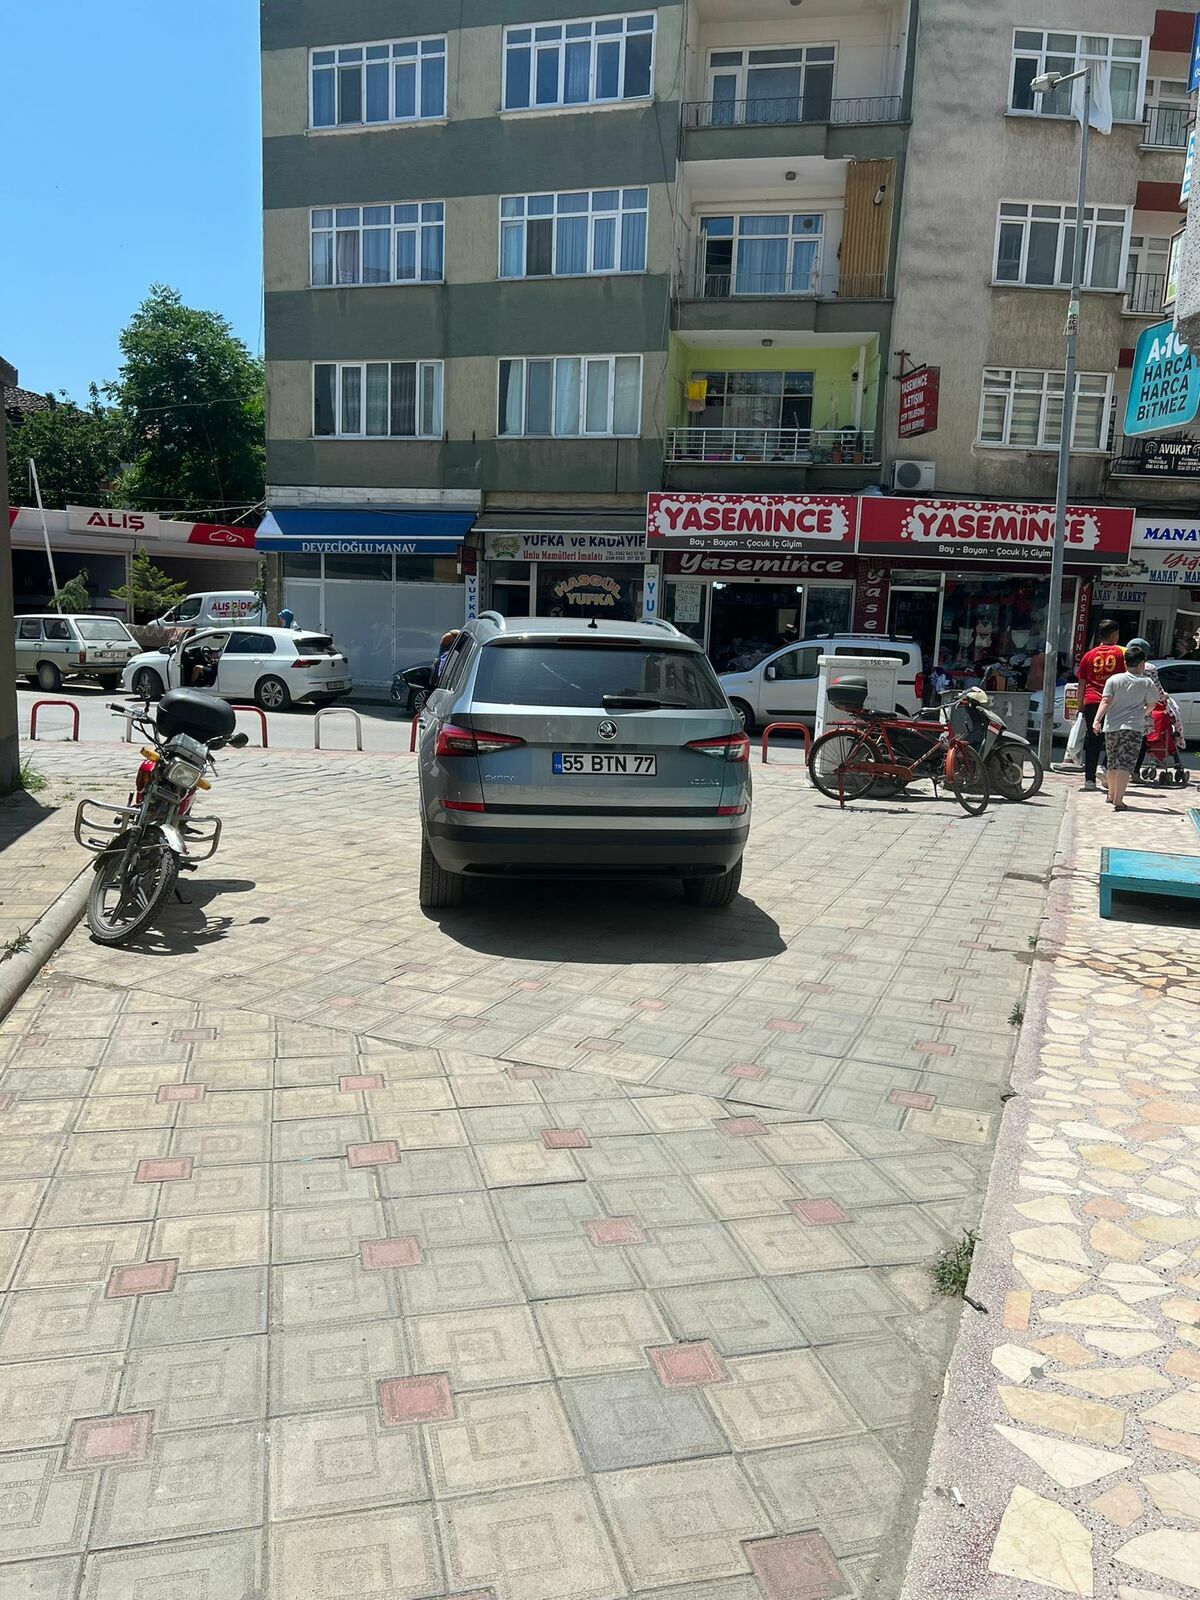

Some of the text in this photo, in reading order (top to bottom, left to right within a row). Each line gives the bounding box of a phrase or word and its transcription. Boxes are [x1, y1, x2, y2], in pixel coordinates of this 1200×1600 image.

[1143, 354, 1192, 383] HARCA
[1140, 375, 1189, 403] HARCA
[1158, 443, 1193, 455] AVUKAT
[664, 499, 833, 533] YASEMİNCE
[523, 535, 565, 547] YUFKA
[570, 536, 586, 547] ve
[589, 535, 645, 547] KADAYIF
[1143, 527, 1200, 542] MANA
[301, 540, 417, 553] DEVECİOĞLU MANAV
[689, 538, 705, 547] Bay
[713, 538, 738, 548] Bayan
[746, 539, 770, 549] Çocuk
[772, 538, 780, 549] İç
[781, 539, 803, 549] Giyim
[938, 544, 954, 554] Bay
[962, 546, 988, 555] Bayan
[996, 547, 1020, 557] Çocuk
[1021, 547, 1029, 558] İç
[1030, 549, 1051, 558] Giyim
[680, 553, 844, 574] Yasemince
[1162, 553, 1200, 571] Yiğ
[1149, 570, 1179, 582] MANAV
[554, 573, 621, 600] HASGÜL
[566, 592, 615, 606] YUFKA
[1116, 590, 1147, 603] MARKET
[1093, 654, 1117, 673] 99
[563, 754, 584, 772] 55
[591, 755, 627, 773] BTN
[633, 756, 654, 773] 77
